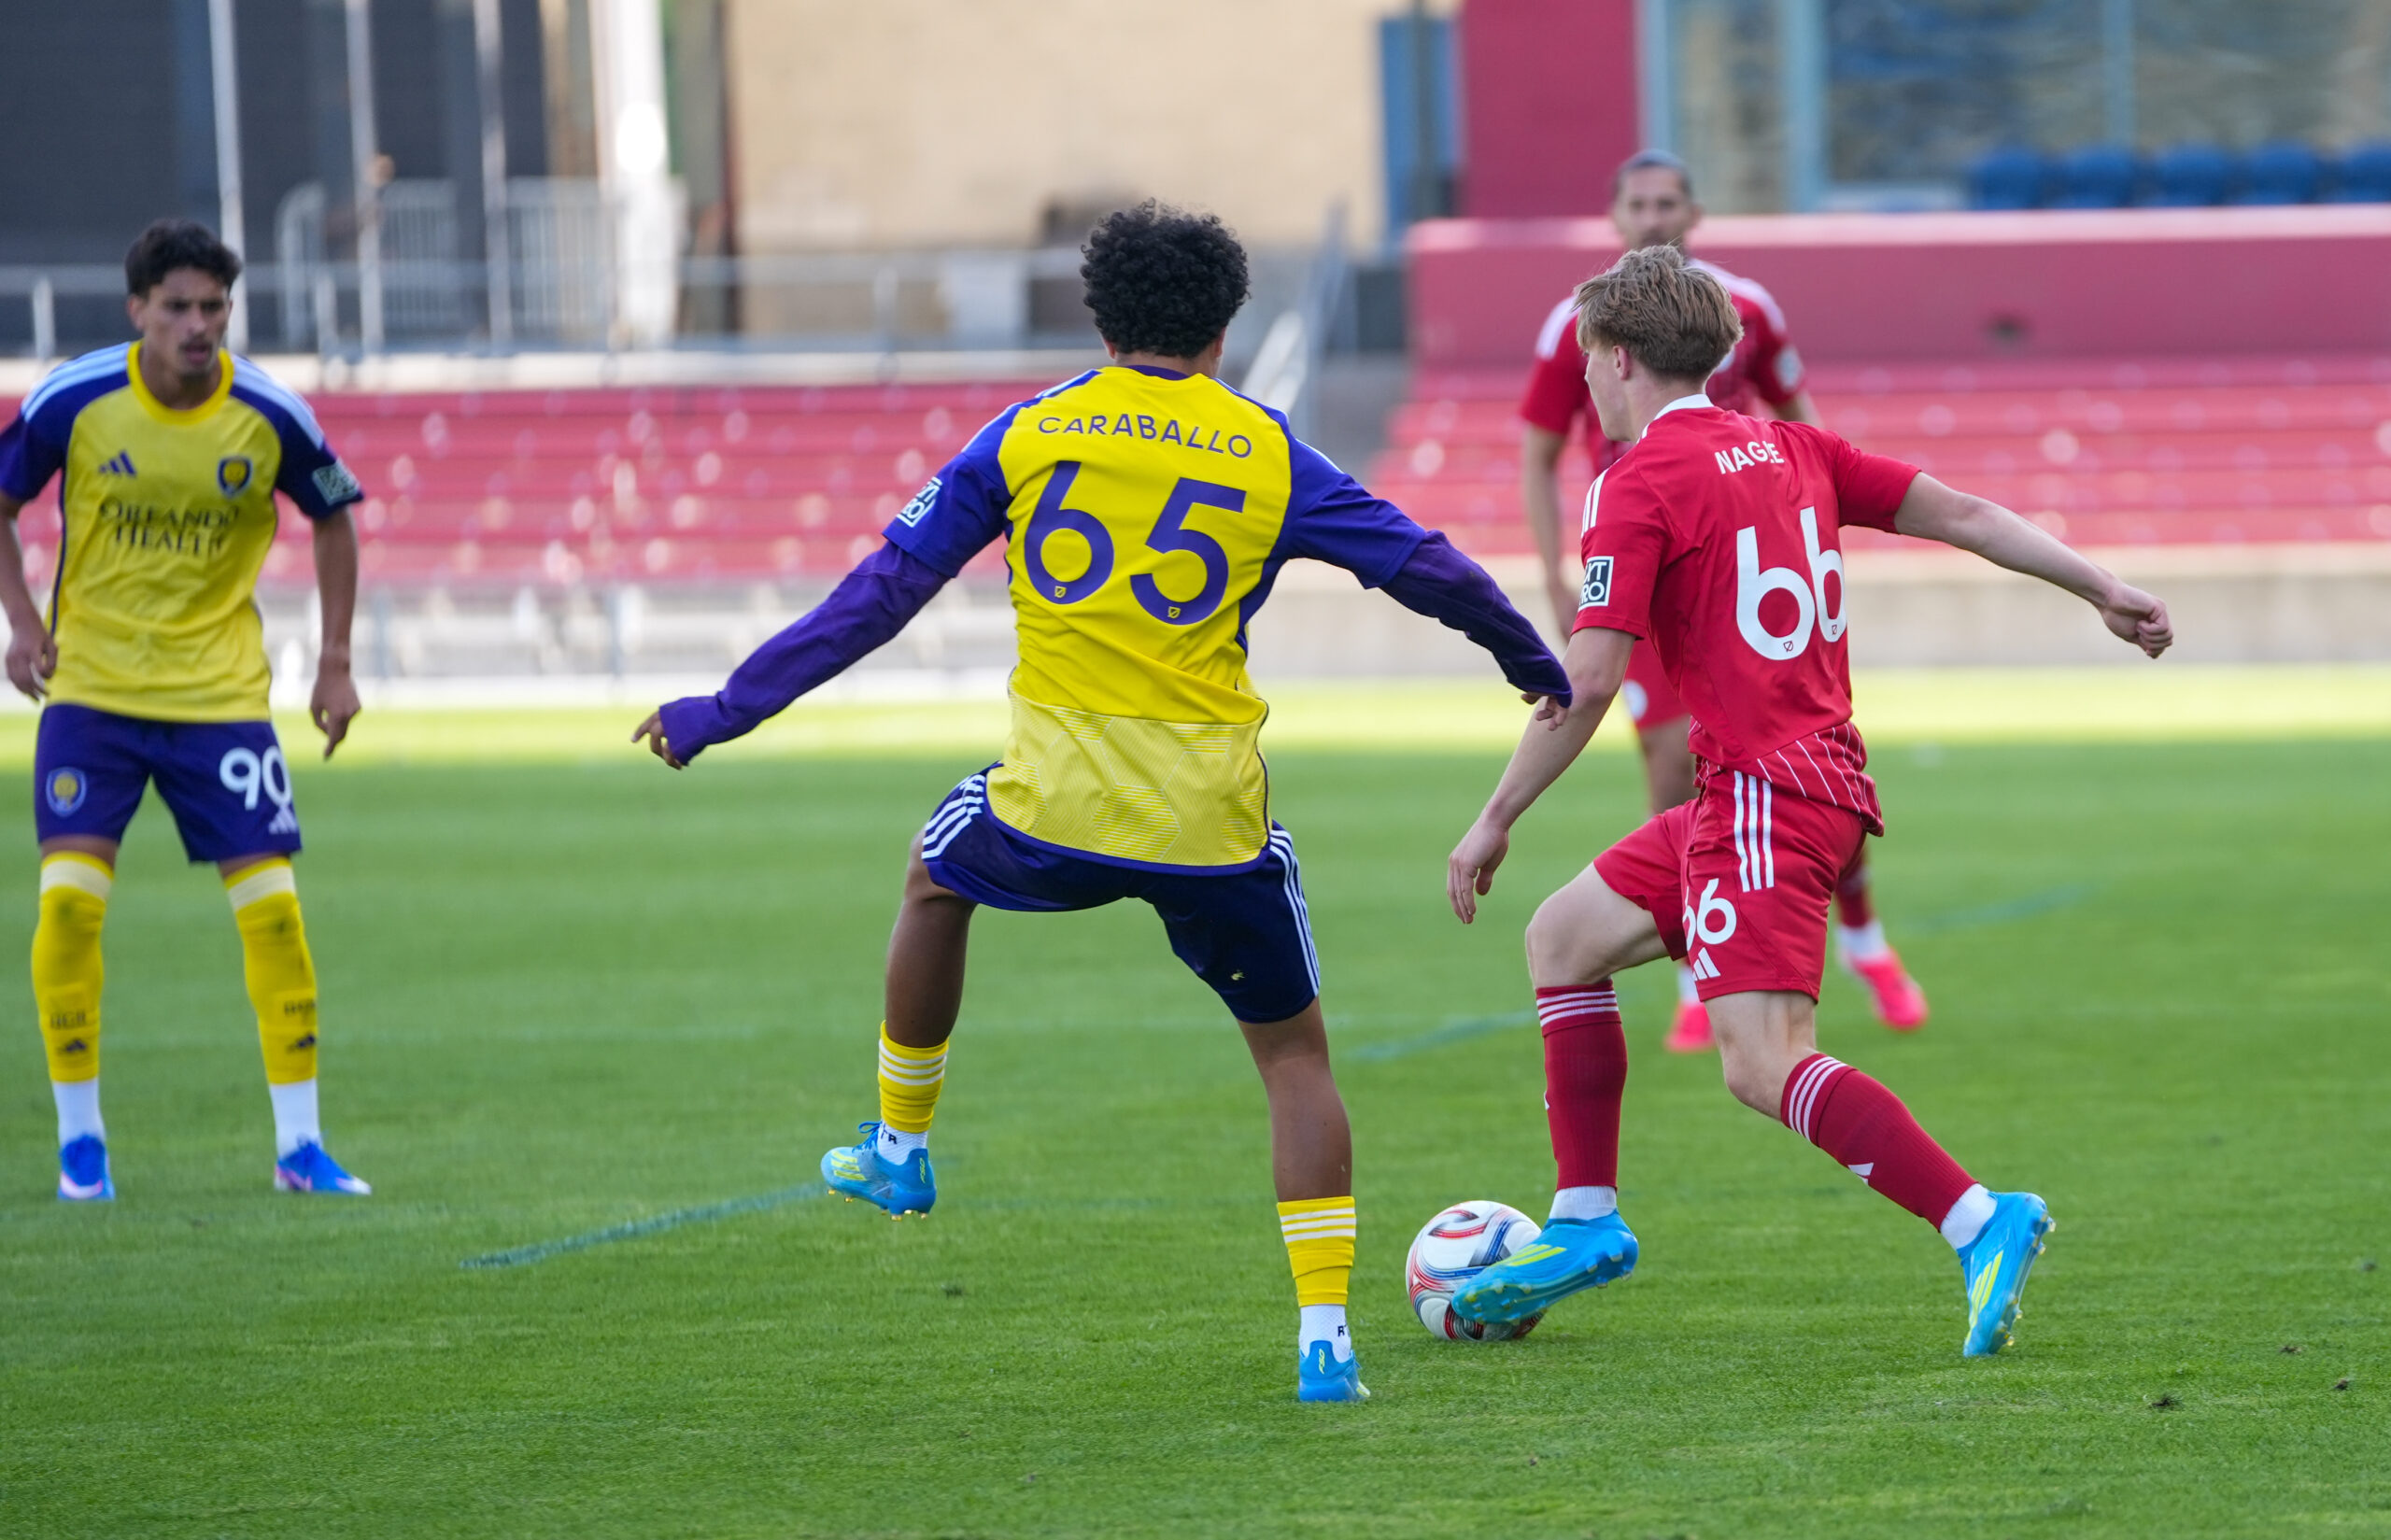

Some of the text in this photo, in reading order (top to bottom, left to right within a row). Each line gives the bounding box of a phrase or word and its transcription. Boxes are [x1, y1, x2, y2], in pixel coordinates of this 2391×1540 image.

[1038, 413, 1253, 459] CARABALLO
[1024, 459, 1247, 626] 65
[1735, 505, 1847, 661] 66
[219, 745, 292, 811] 90
